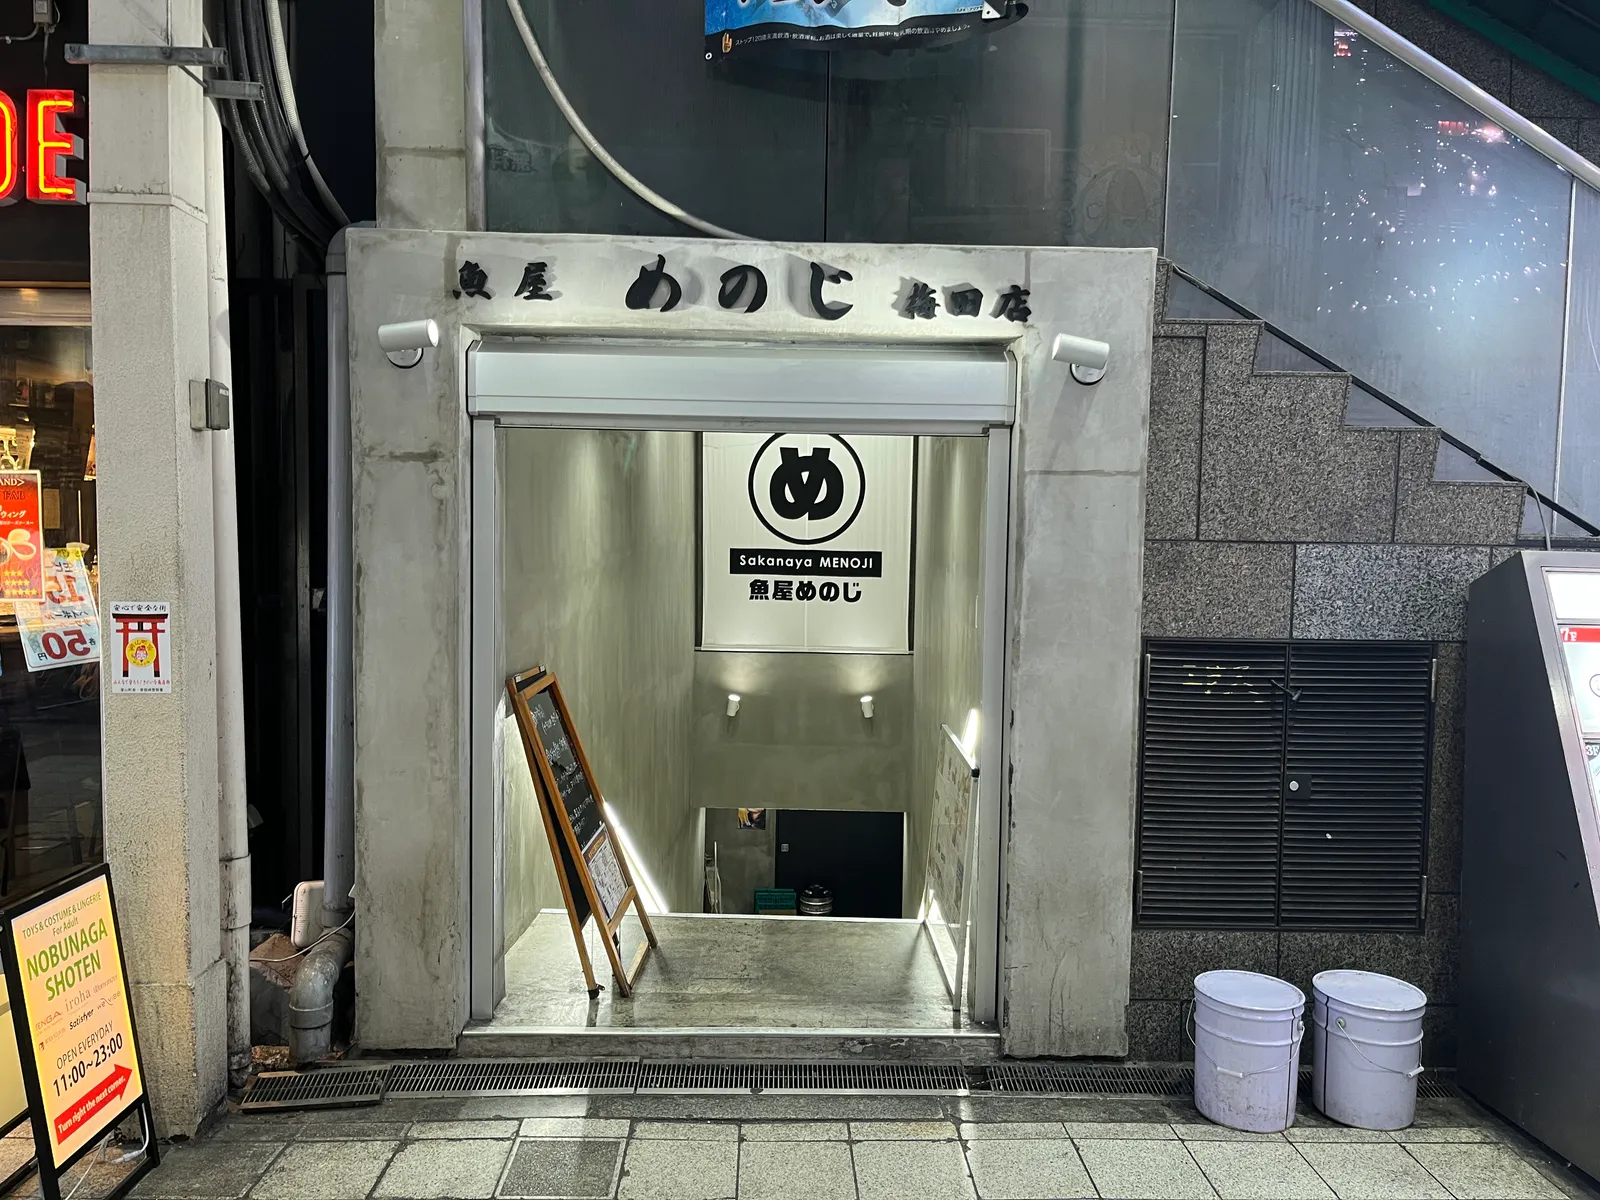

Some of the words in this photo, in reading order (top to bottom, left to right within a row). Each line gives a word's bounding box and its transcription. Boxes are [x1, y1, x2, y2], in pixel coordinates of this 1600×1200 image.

[452, 260, 550, 302] 魚屋
[625, 253, 854, 321] めのじ
[904, 281, 1034, 323] 梅田店
[739, 555, 813, 569] Sakanaya
[819, 557, 873, 569] MENOJI
[749, 579, 862, 603] 魚屋めのじ
[1561, 627, 1578, 641] 7F
[1586, 744, 1600, 756] 3F
[52, 927, 63, 937] For
[63, 917, 79, 931] Adult
[26, 917, 108, 981] NOBUNAGA
[45, 949, 102, 1002] SHOTEN
[65, 989, 91, 1012] iroha
[56, 1049, 78, 1069] OPEN
[78, 1020, 113, 1054] EVERYDAY
[57, 1120, 73, 1134] Turn
[72, 1107, 87, 1125] right
[85, 1100, 97, 1112] the
[95, 1089, 109, 1105] next
